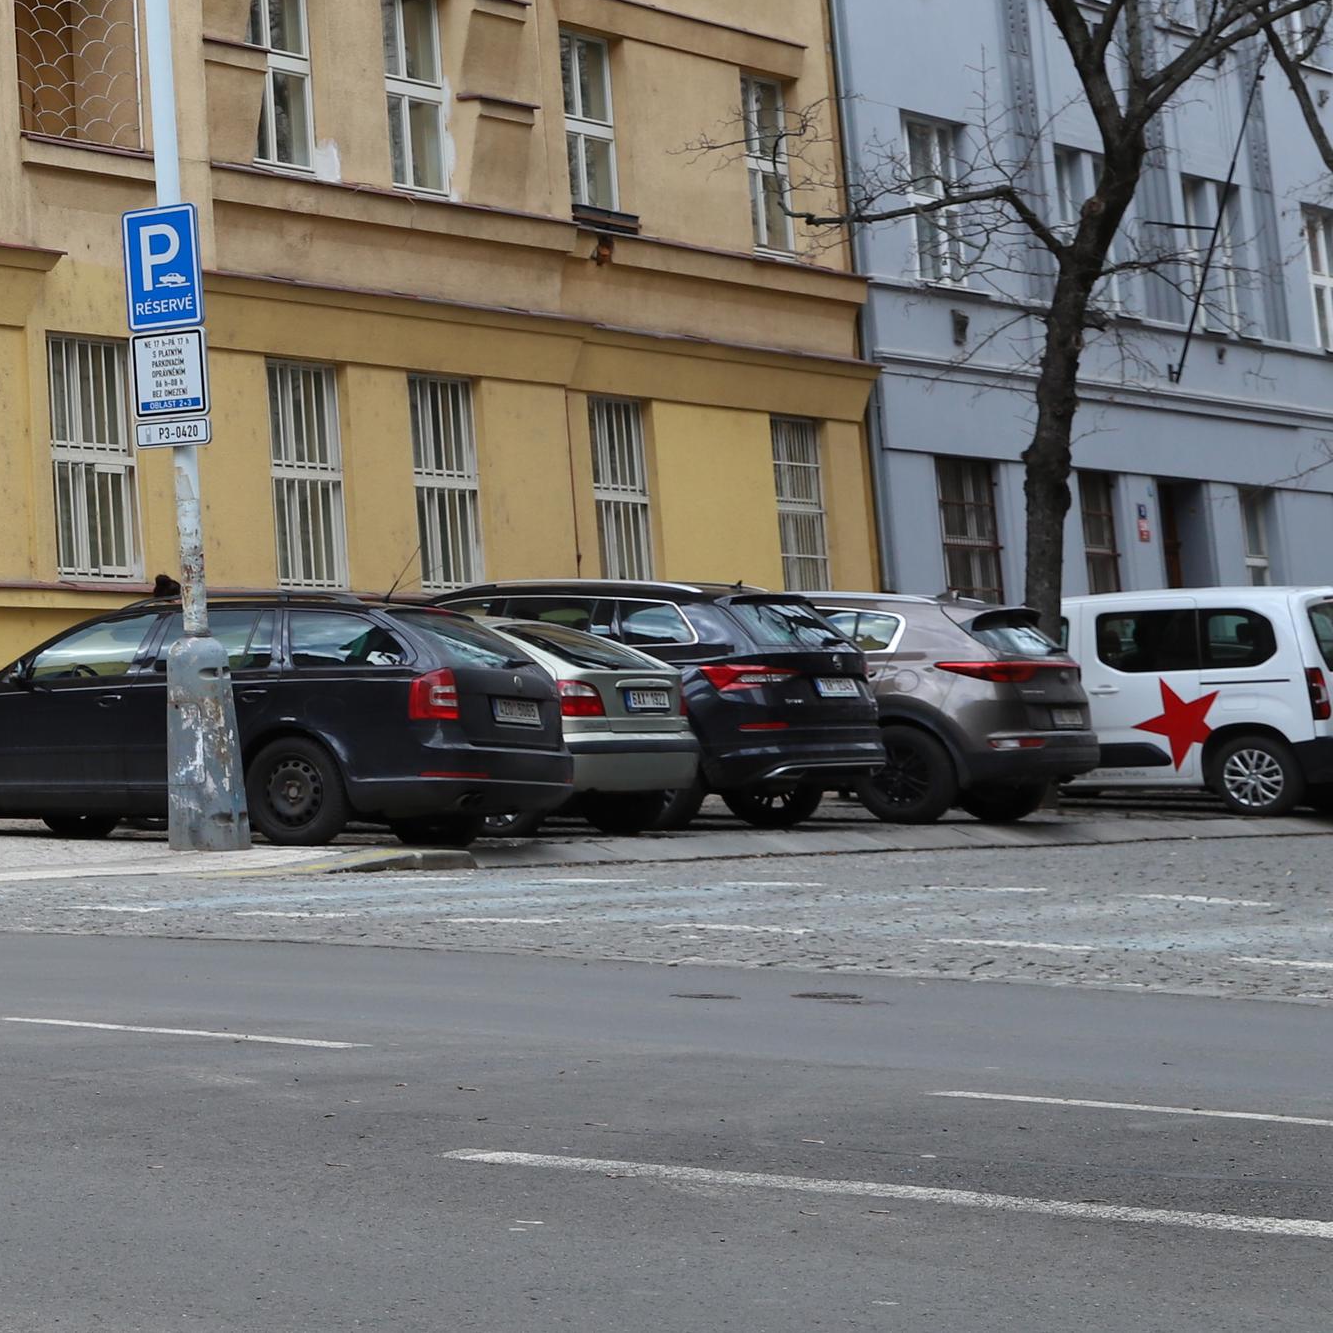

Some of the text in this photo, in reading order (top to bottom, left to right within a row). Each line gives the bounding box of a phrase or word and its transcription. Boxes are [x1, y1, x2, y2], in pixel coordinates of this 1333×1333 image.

[139, 224, 180, 291] P
[136, 293, 193, 315] RÉSERVÉ
[158, 347, 183, 357] PLATNÝM
[152, 357, 185, 368] PARKOVACÍM
[152, 387, 188, 398] BEZ OMEZENÍ
[149, 400, 176, 410] OBLAST
[159, 425, 199, 440] P3-0420
